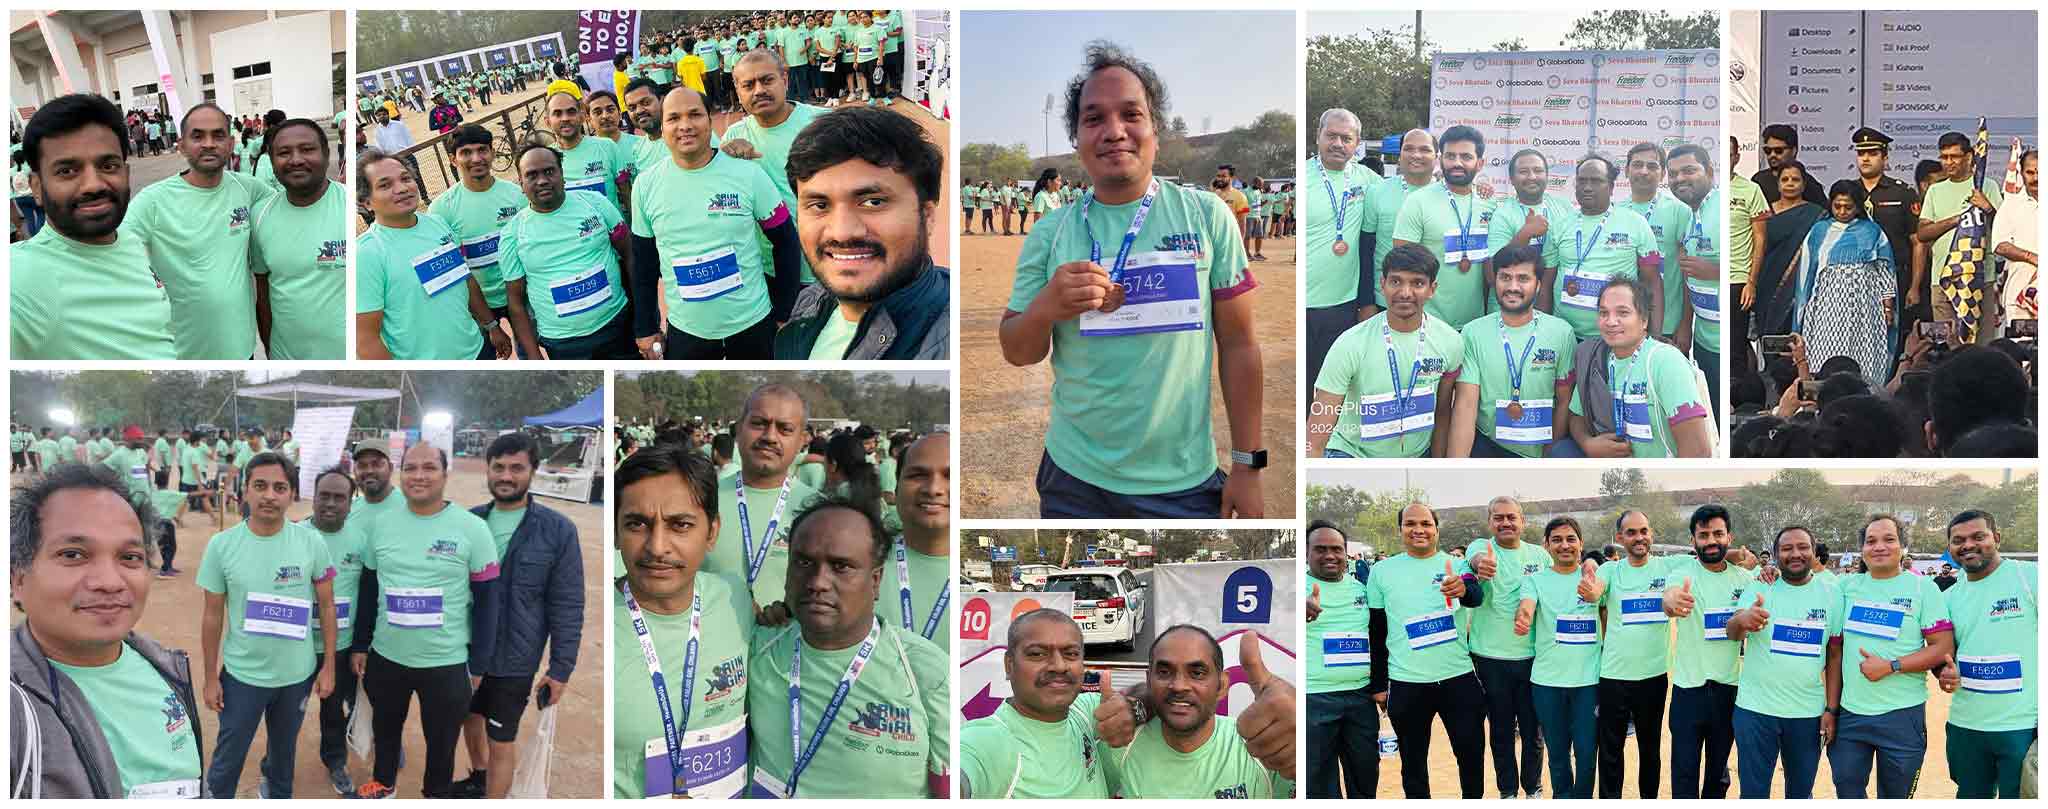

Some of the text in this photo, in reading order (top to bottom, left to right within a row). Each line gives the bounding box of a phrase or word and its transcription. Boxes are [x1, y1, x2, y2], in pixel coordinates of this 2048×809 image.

[1801, 28, 1832, 38] Desktop
[1895, 24, 1922, 32] AUDIO
[579, 27, 592, 54] ON
[596, 28, 609, 53] TO
[1801, 47, 1842, 55] Downloads
[1801, 67, 1841, 75] Documents
[1801, 86, 1829, 94] Pictures
[1907, 84, 1931, 92] Videos
[1801, 105, 1822, 113] Music
[1800, 124, 1825, 133] Videos
[1819, 144, 1840, 153] drops
[430, 255, 455, 273] F5742
[688, 263, 721, 280] F5611
[567, 278, 597, 297] F5739
[1122, 272, 1166, 294] 5742
[1235, 585, 1259, 614] 5
[263, 604, 294, 619] F6213
[961, 610, 987, 632] 10
[1081, 622, 1098, 630] ICE
[859, 641, 872, 658] 5K
[1972, 665, 2004, 676] F5620
[879, 703, 911, 721] RUN
[880, 716, 913, 734] GIRL
